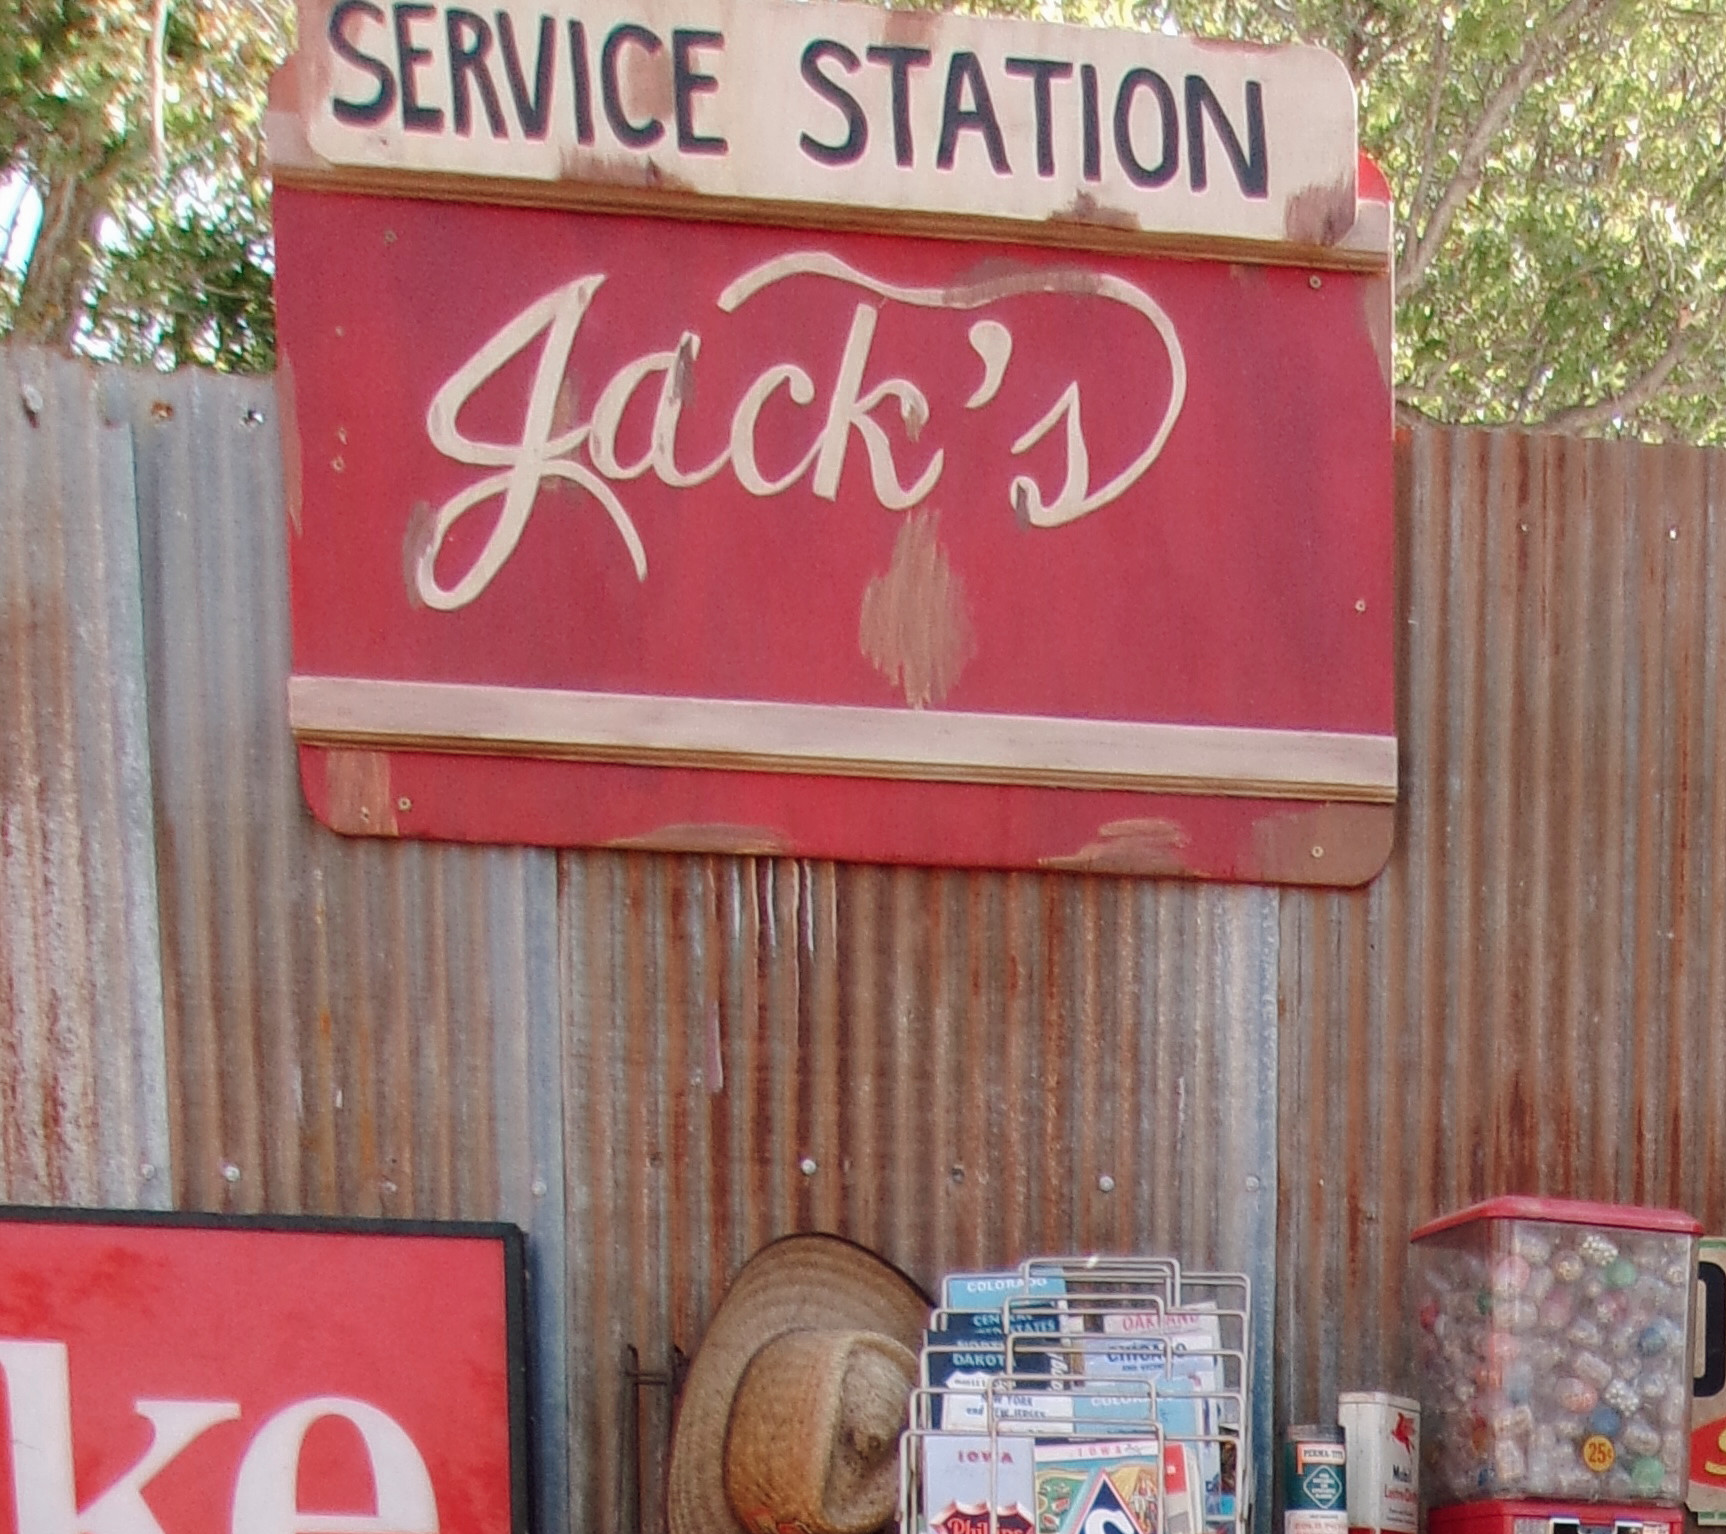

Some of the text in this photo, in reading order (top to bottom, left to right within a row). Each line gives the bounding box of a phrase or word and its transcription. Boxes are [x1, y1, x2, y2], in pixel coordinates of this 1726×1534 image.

[330, 0, 1269, 201] SERVICE STATION
[416, 250, 1187, 610] Jack's
